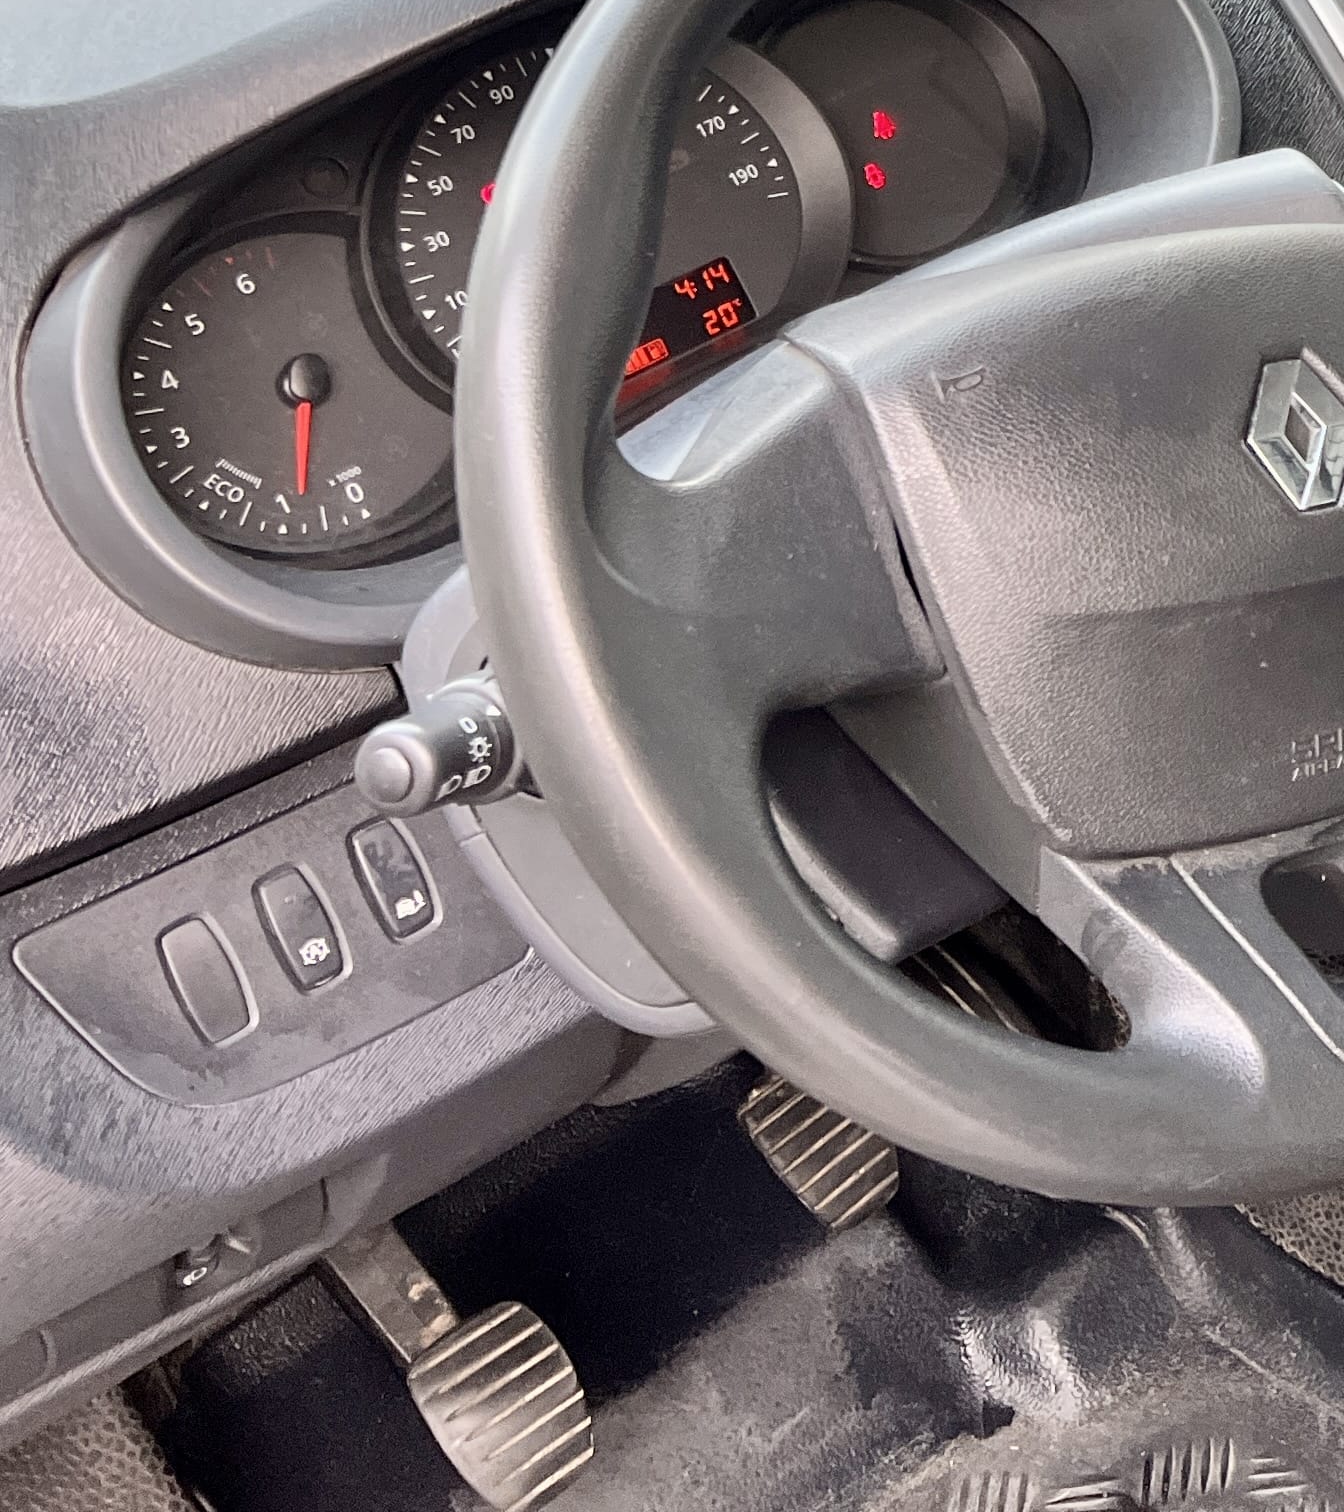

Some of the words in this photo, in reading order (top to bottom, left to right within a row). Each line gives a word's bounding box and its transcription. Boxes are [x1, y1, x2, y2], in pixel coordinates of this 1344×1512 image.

[489, 85, 514, 105] 90
[450, 124, 476, 144] 70
[696, 115, 726, 138] 170
[728, 163, 759, 186] 190
[427, 175, 453, 196] 50
[423, 231, 450, 252] 30
[235, 273, 256, 295] 6
[674, 264, 730, 300] 4:14
[444, 290, 468, 311] 10
[184, 313, 206, 336] 5
[161, 369, 179, 390] 4
[170, 426, 190, 449] 3
[203, 473, 245, 504] ECO
[345, 482, 364, 503] 0
[275, 494, 291, 514] 1
